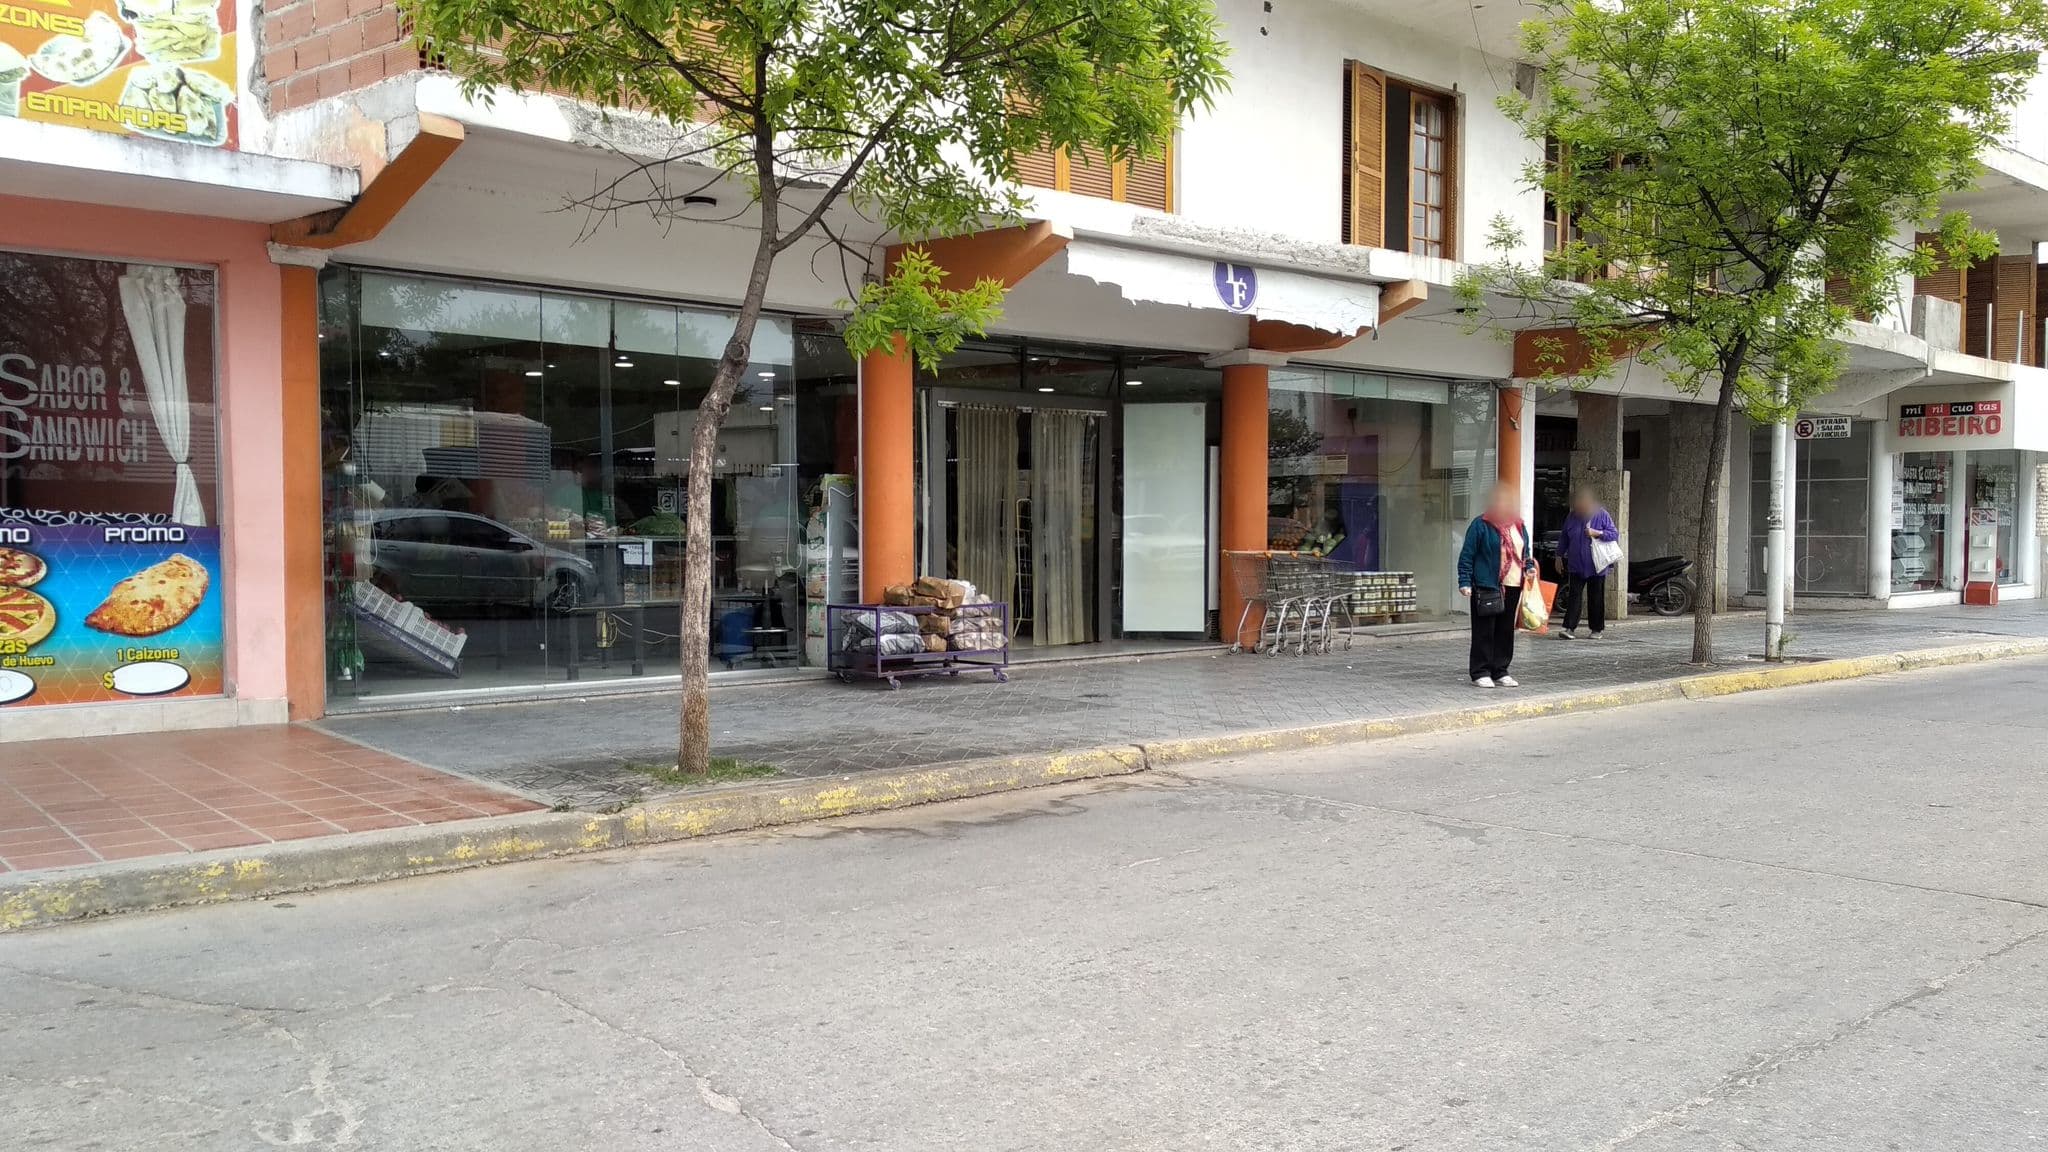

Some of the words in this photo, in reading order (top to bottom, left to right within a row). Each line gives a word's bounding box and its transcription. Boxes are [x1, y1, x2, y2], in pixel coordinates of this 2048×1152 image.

[27, 91, 188, 133] EMPANADAS
[0, 353, 108, 411] SABOR
[117, 367, 135, 413] &
[0, 405, 148, 463] SANDWICH
[1899, 414, 2002, 437] RIBEIRO
[3, 656, 17, 666] de
[19, 655, 54, 666] Huevo
[117, 649, 123, 662] 1
[127, 648, 179, 661] Calzone
[103, 671, 115, 690] $
